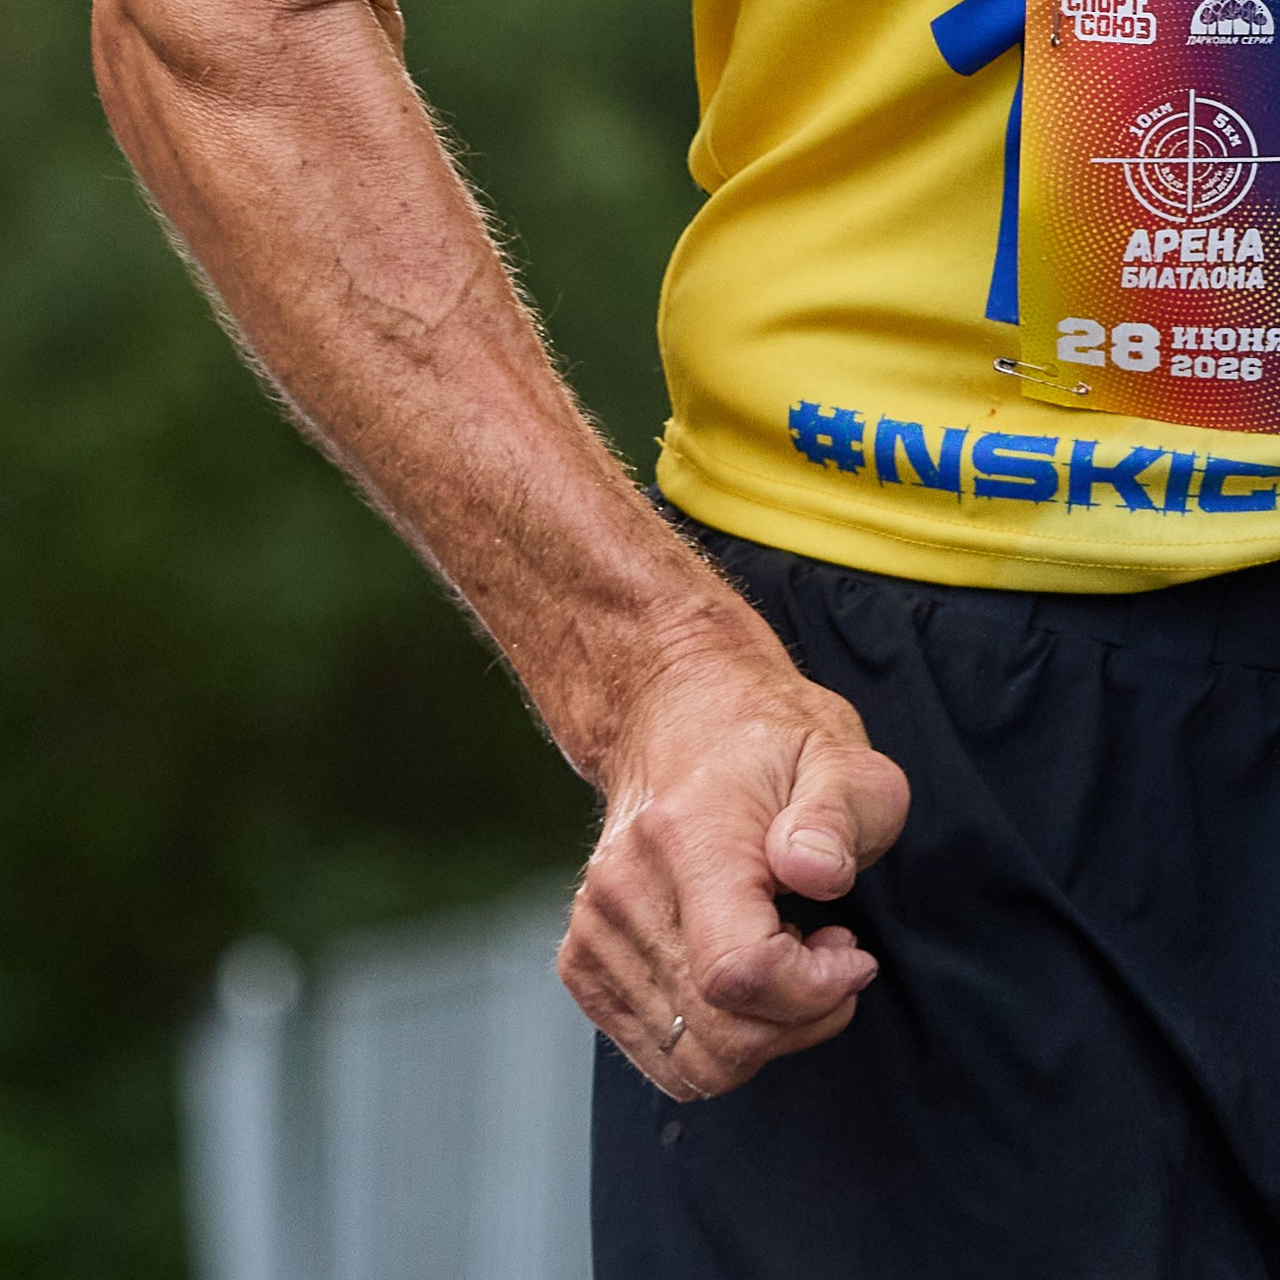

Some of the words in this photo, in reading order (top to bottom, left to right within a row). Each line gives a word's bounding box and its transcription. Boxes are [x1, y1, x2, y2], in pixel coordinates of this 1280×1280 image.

[1080, 13, 1152, 40] СОЮЗ
[1122, 228, 1265, 263] АРЕНА
[1120, 266, 1266, 290] БИАТЛОНА
[1056, 316, 1161, 373] 28
[1170, 354, 1263, 381] 2026
